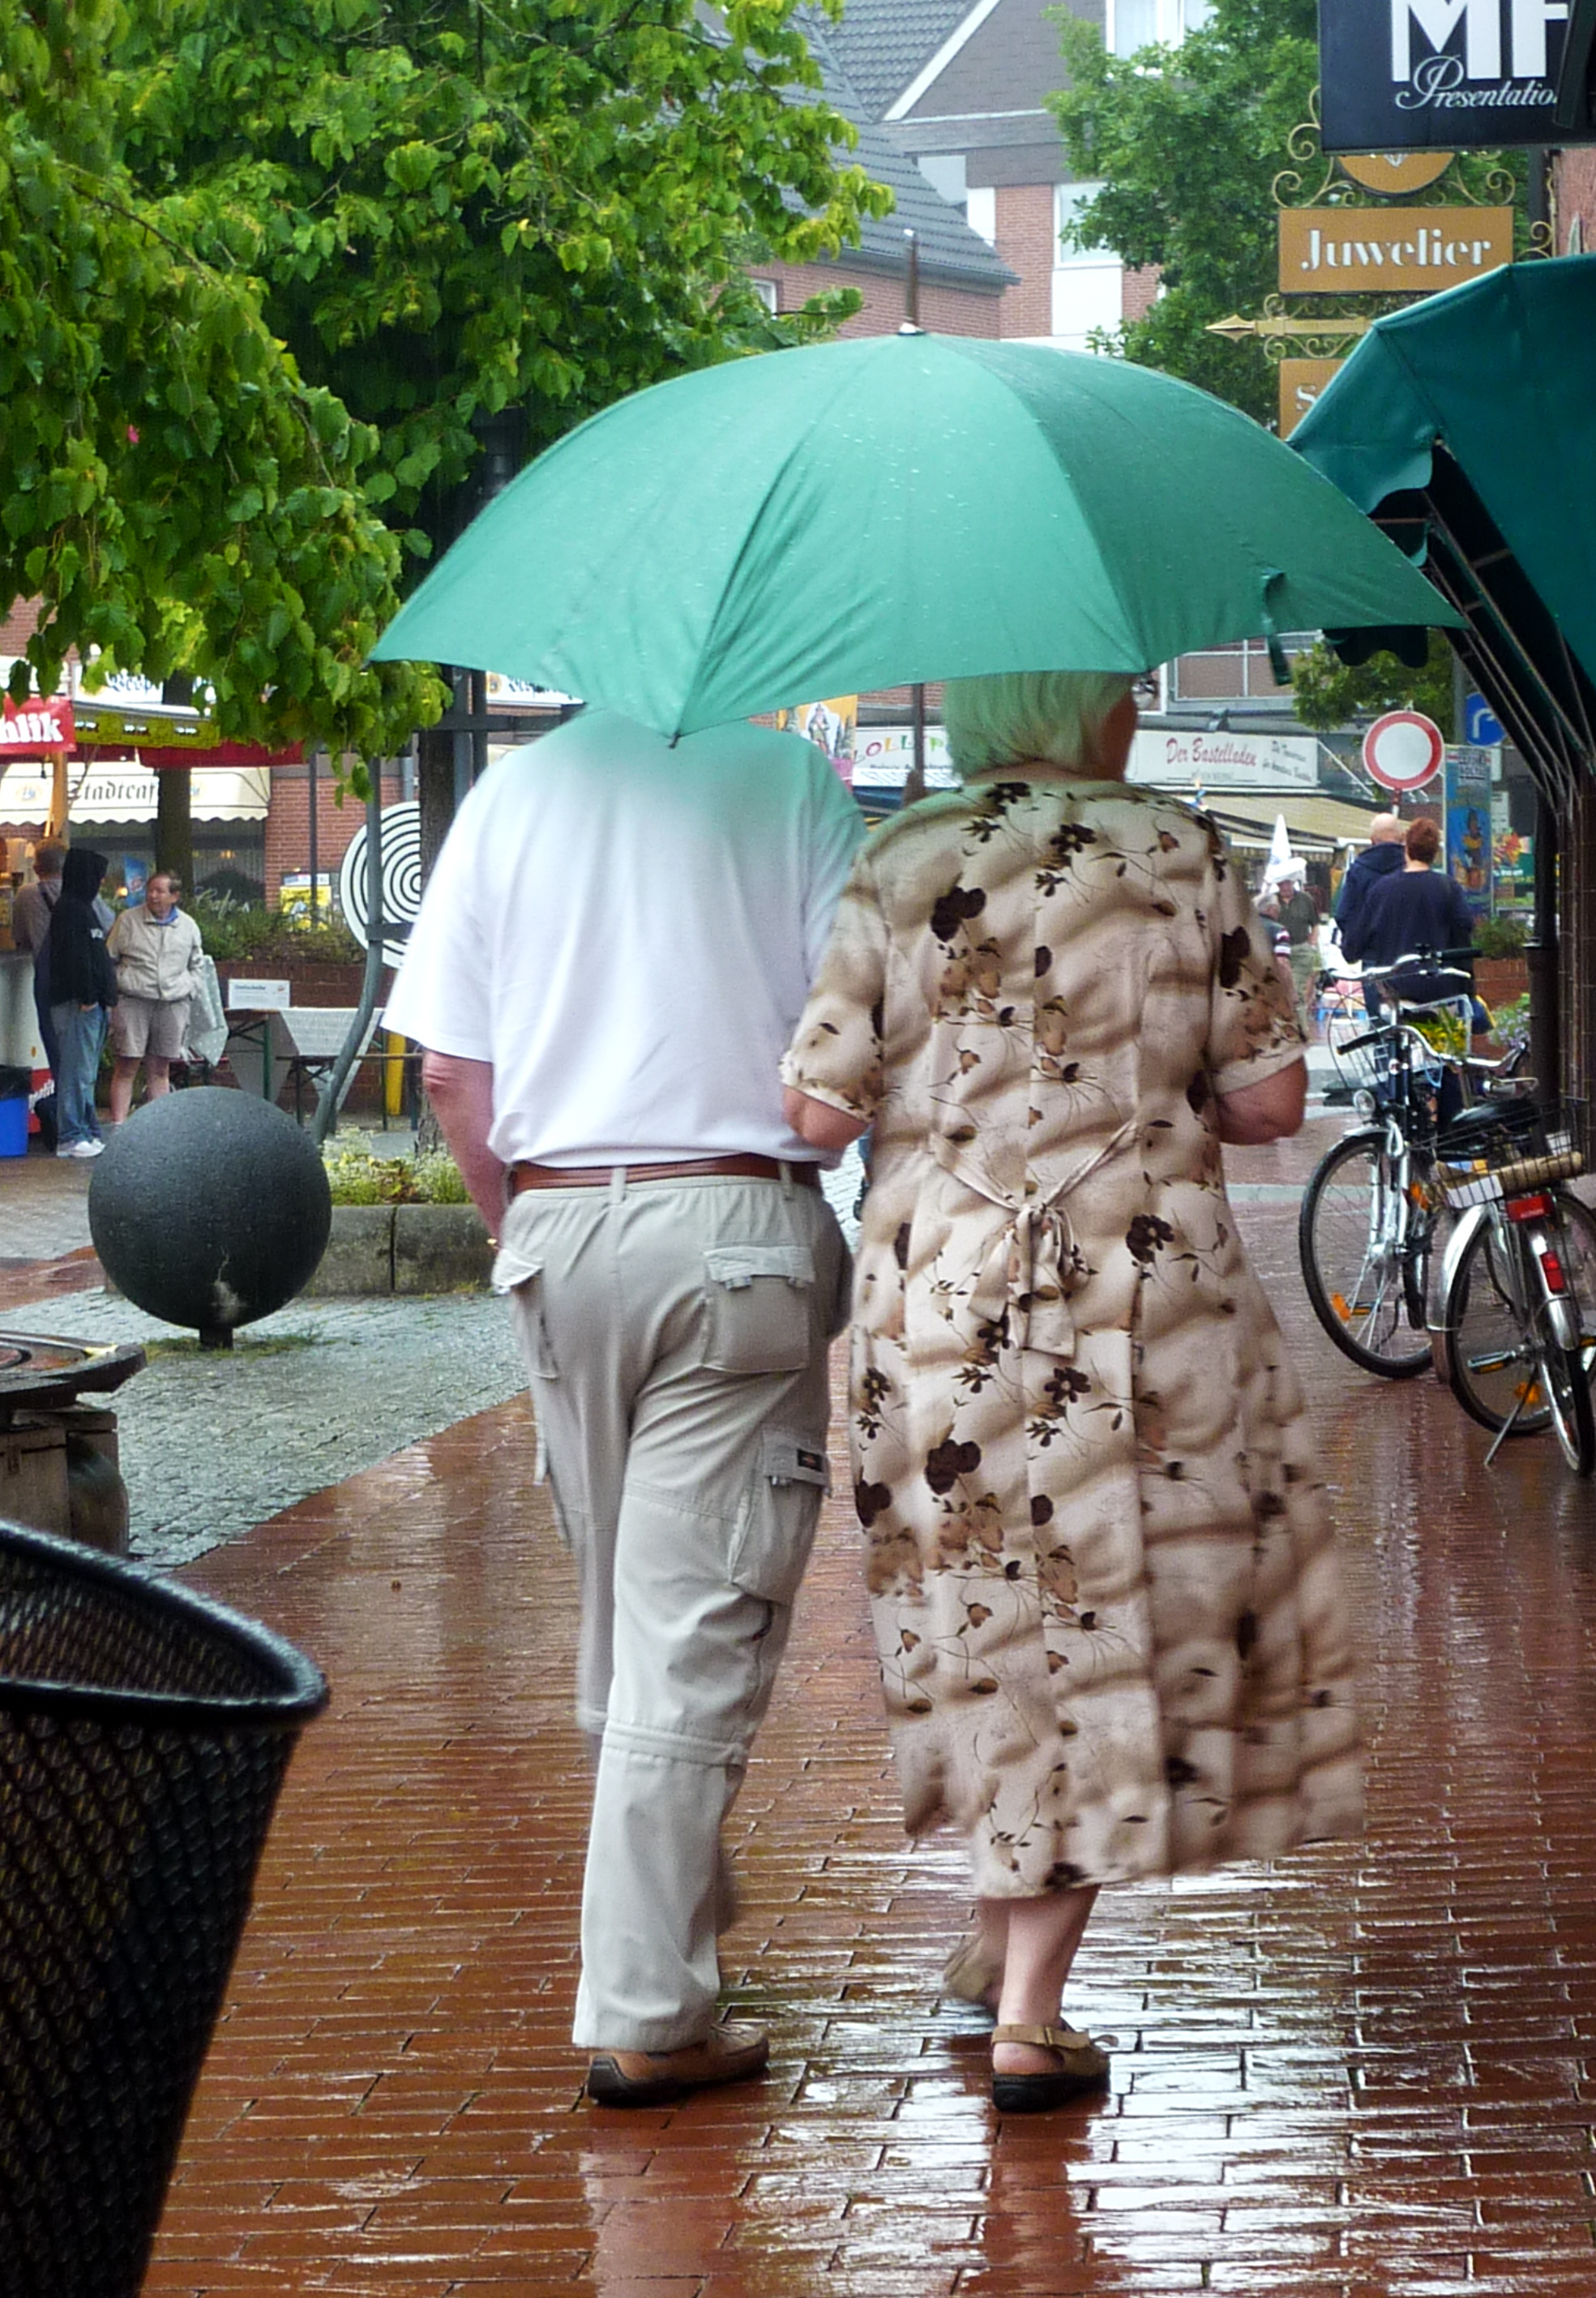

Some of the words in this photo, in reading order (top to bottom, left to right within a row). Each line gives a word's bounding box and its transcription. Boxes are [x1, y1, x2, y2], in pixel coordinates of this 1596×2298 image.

[1396, 54, 1557, 109] Presentatio
[1301, 229, 1491, 270] Juwelier
[1166, 738, 1188, 764] Der
[1192, 737, 1256, 767] Bastelladen
[67, 779, 157, 806] Stadtcaf
